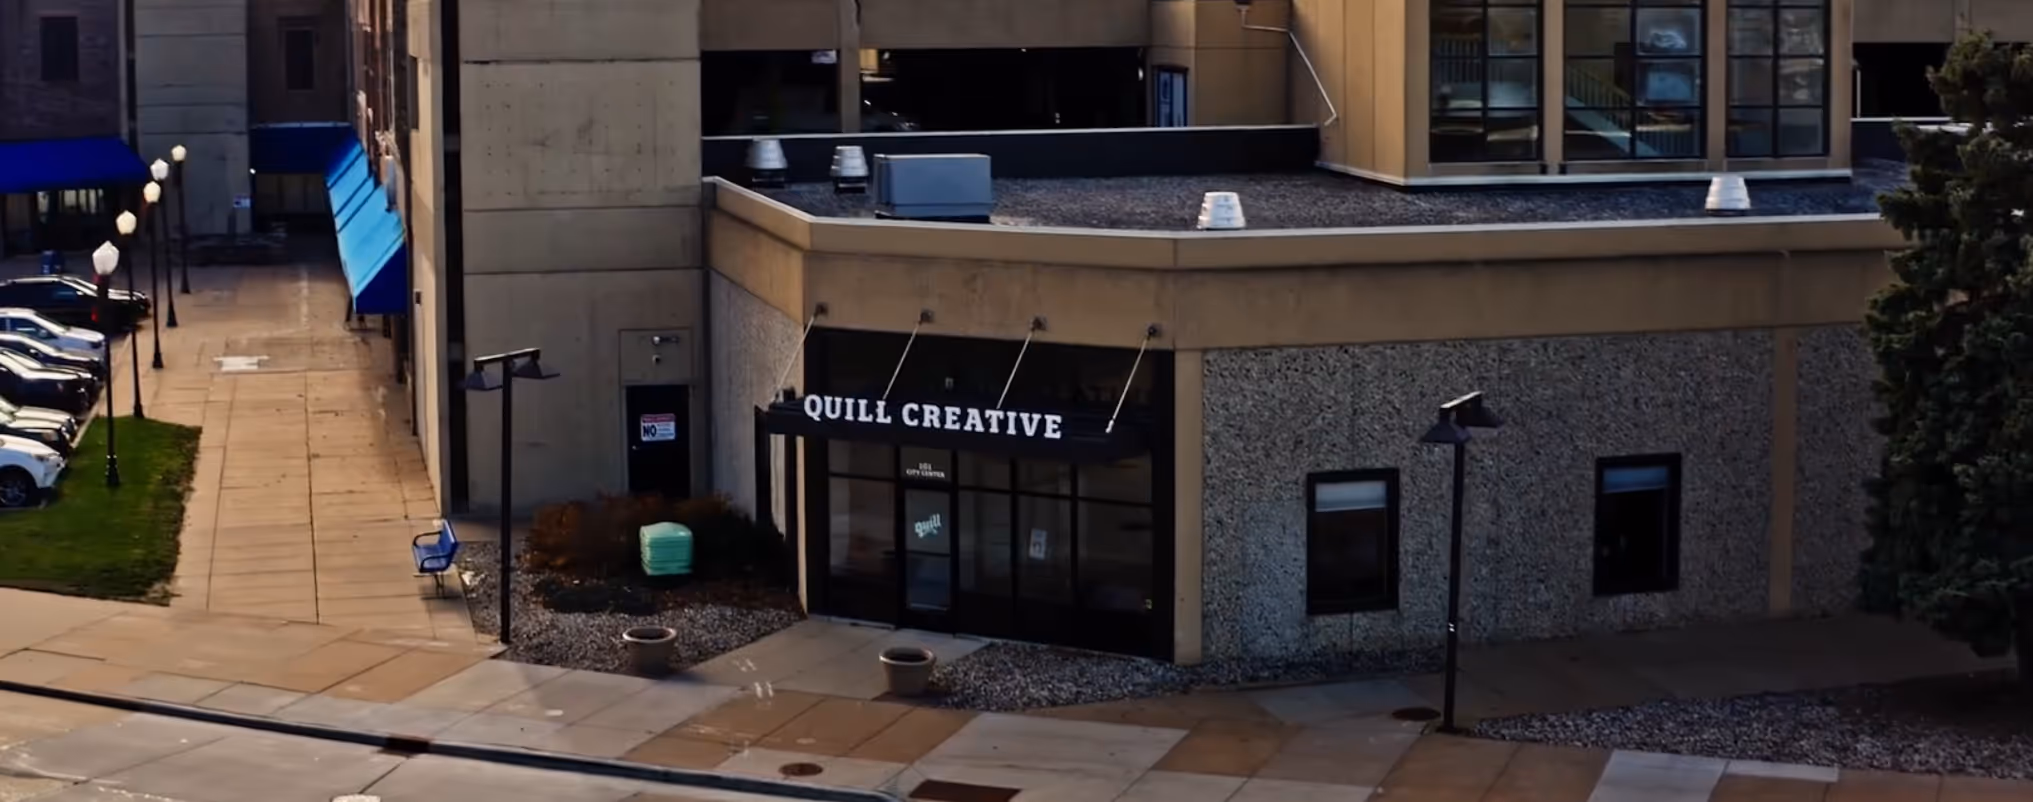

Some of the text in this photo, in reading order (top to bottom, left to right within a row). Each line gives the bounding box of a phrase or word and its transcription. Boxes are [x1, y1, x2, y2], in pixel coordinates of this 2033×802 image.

[643, 424, 656, 437] NO
[804, 394, 1062, 439] QUILL CREATIVE
